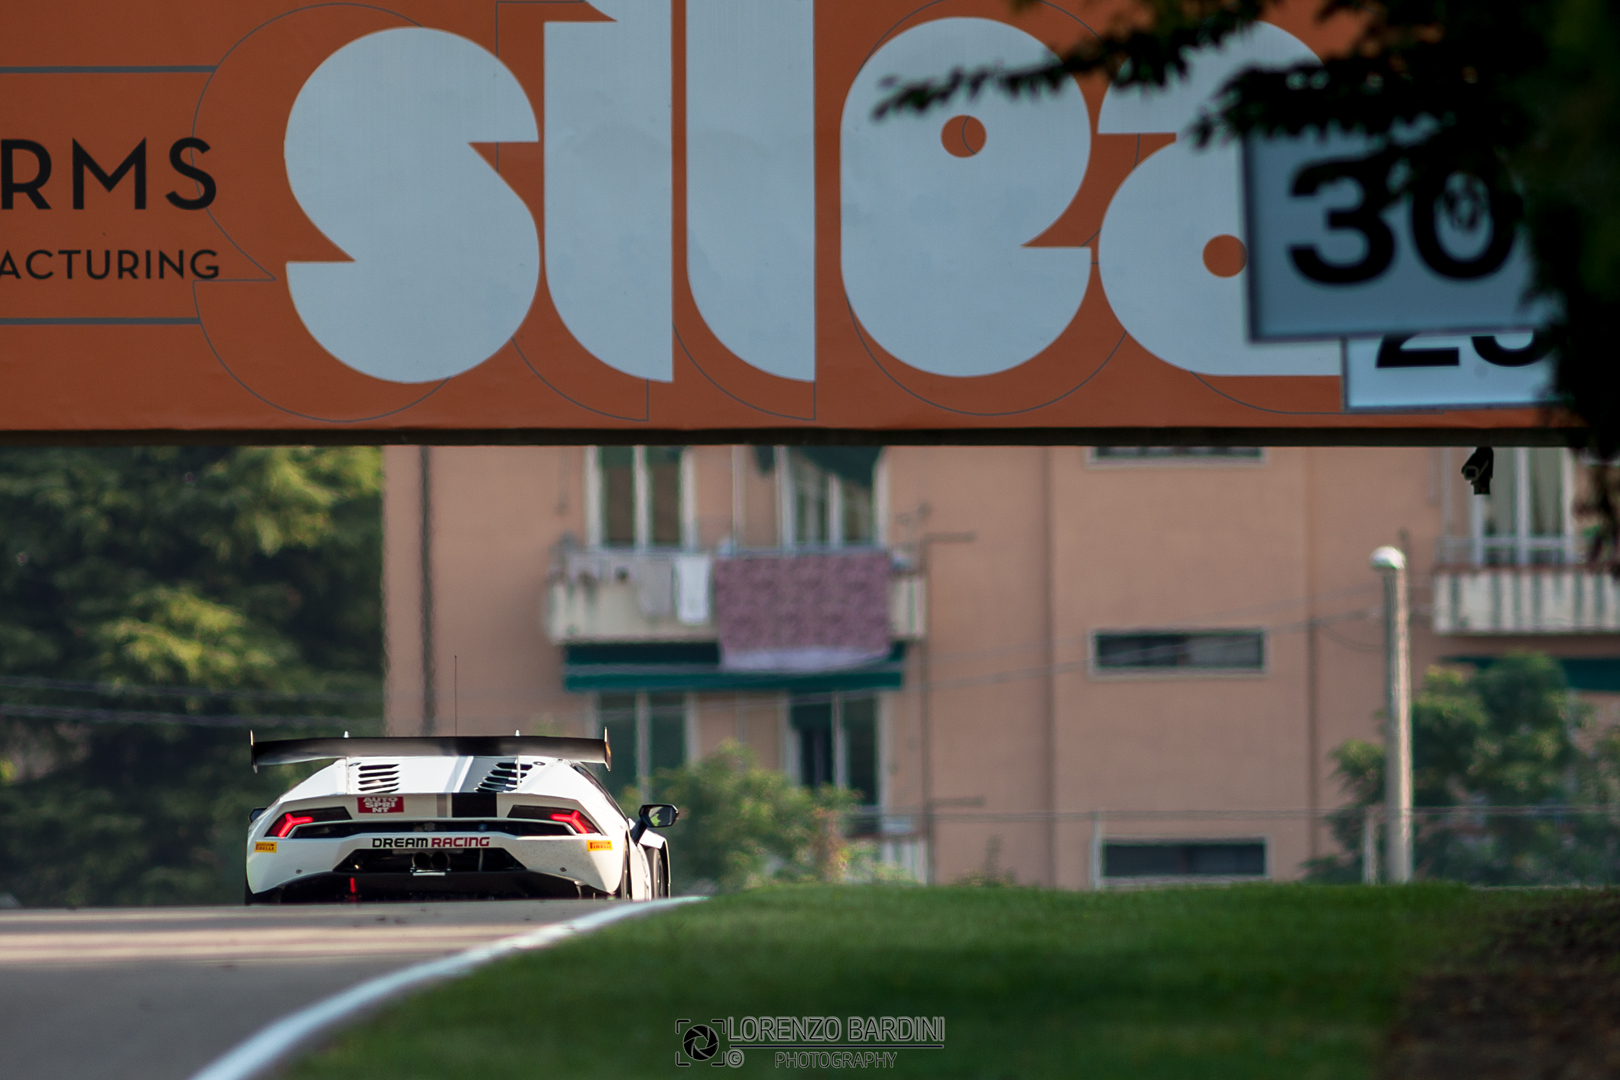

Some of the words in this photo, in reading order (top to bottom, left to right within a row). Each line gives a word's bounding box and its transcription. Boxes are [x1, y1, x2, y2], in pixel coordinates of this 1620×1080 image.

[0, 137, 217, 211] RMS
[371, 837, 428, 848] DREAM
[431, 836, 490, 848] RACING
